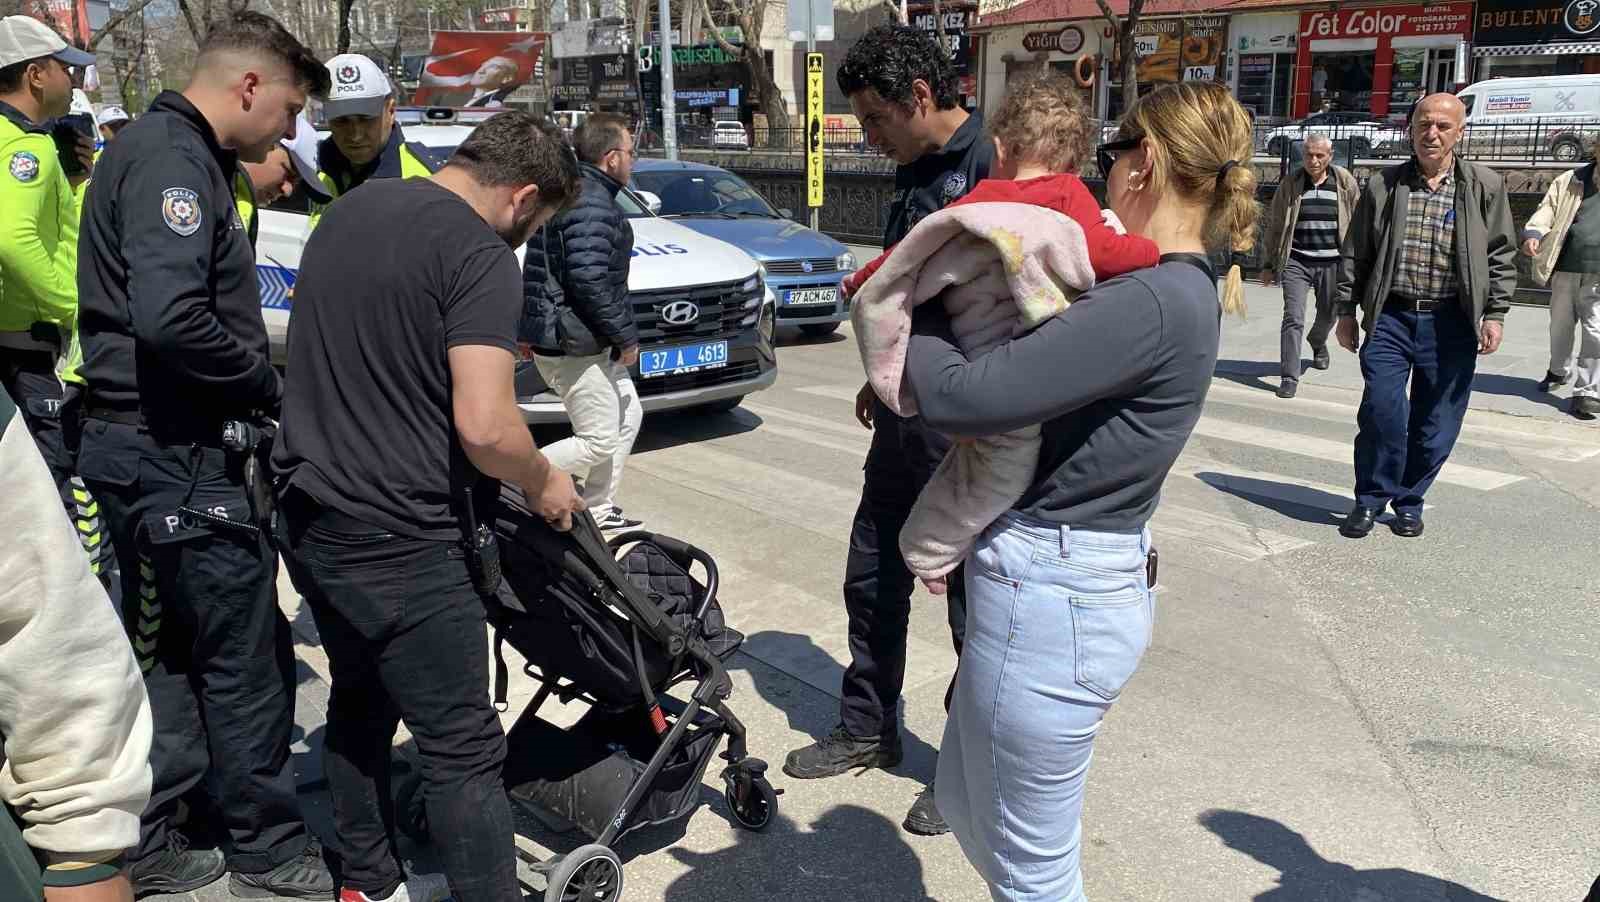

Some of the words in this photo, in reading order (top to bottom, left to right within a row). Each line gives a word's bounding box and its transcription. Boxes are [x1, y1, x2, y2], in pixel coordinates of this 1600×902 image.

[1301, 12, 1339, 37] Set
[1346, 10, 1407, 35] Color
[652, 351, 668, 369] 37
[676, 349, 685, 367] A
[698, 343, 725, 362] 4613
